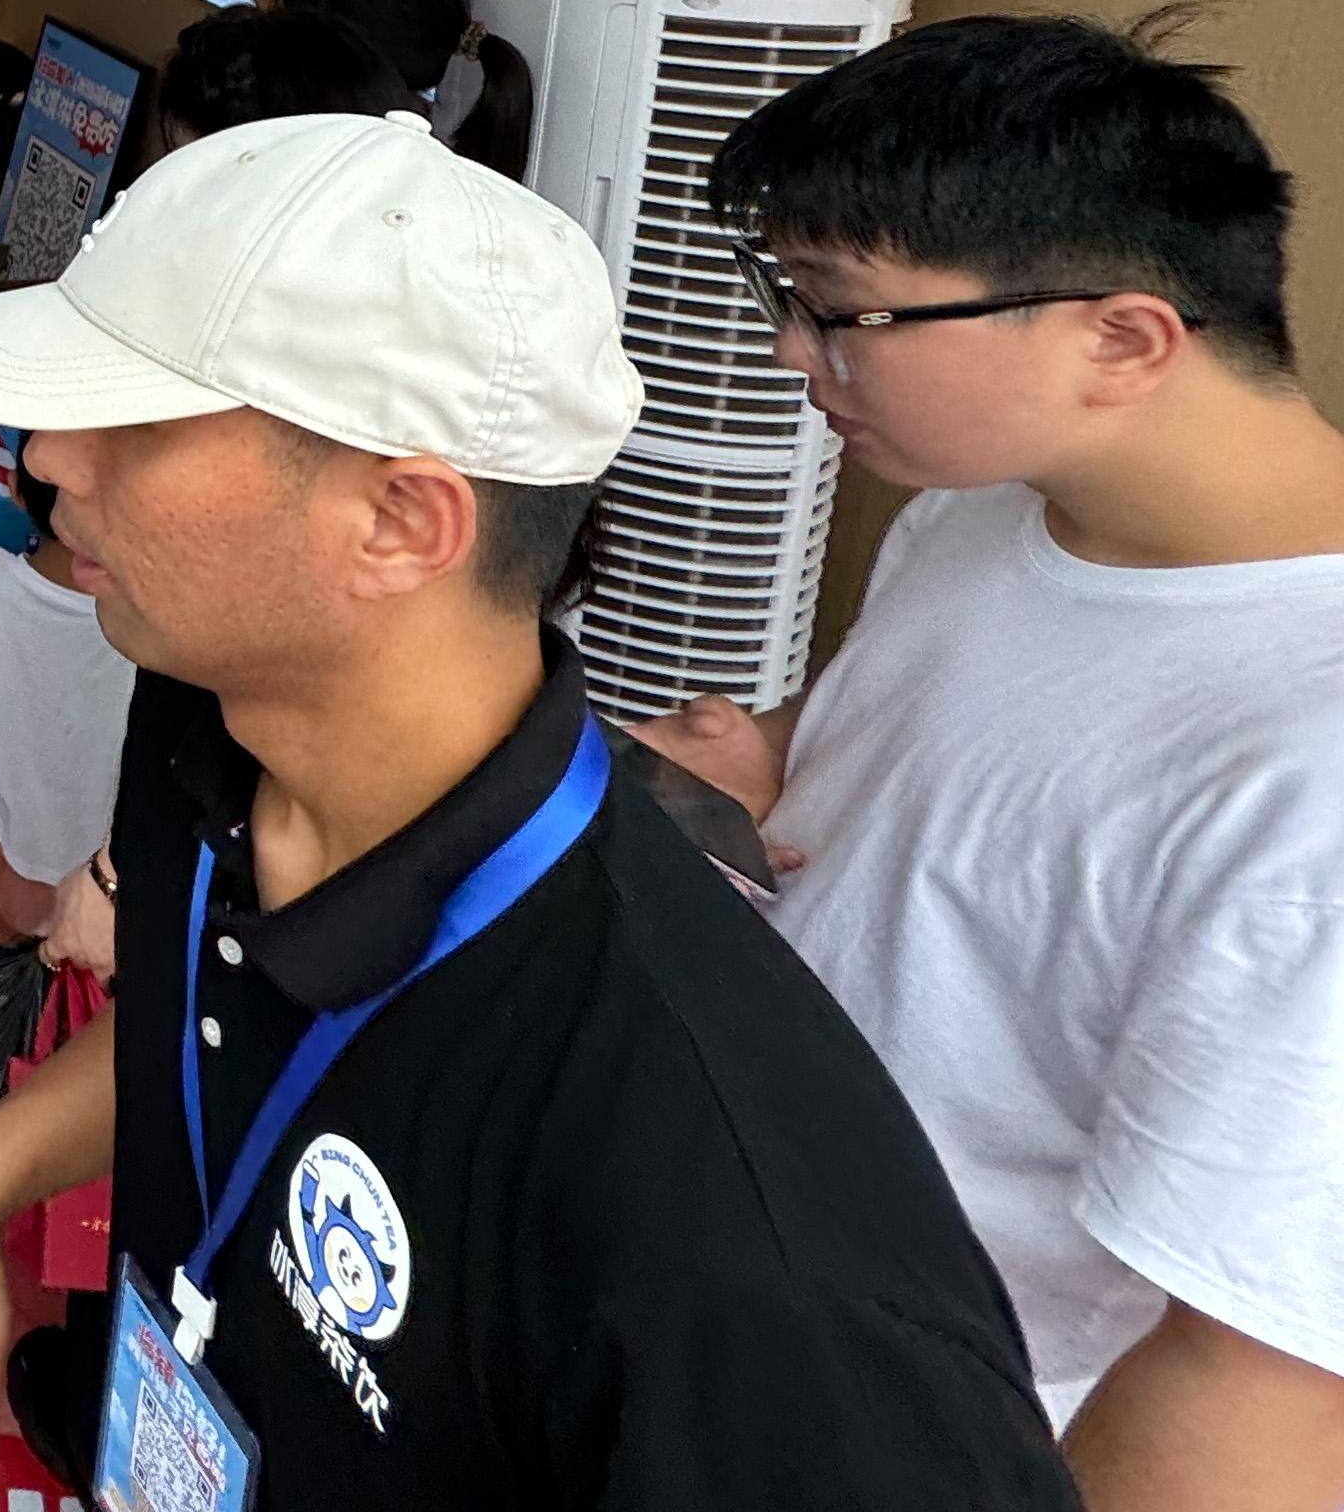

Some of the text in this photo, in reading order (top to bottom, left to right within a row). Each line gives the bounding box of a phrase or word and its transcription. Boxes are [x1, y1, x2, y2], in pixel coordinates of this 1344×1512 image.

[321, 1148, 397, 1253] BING CHUN TEA
